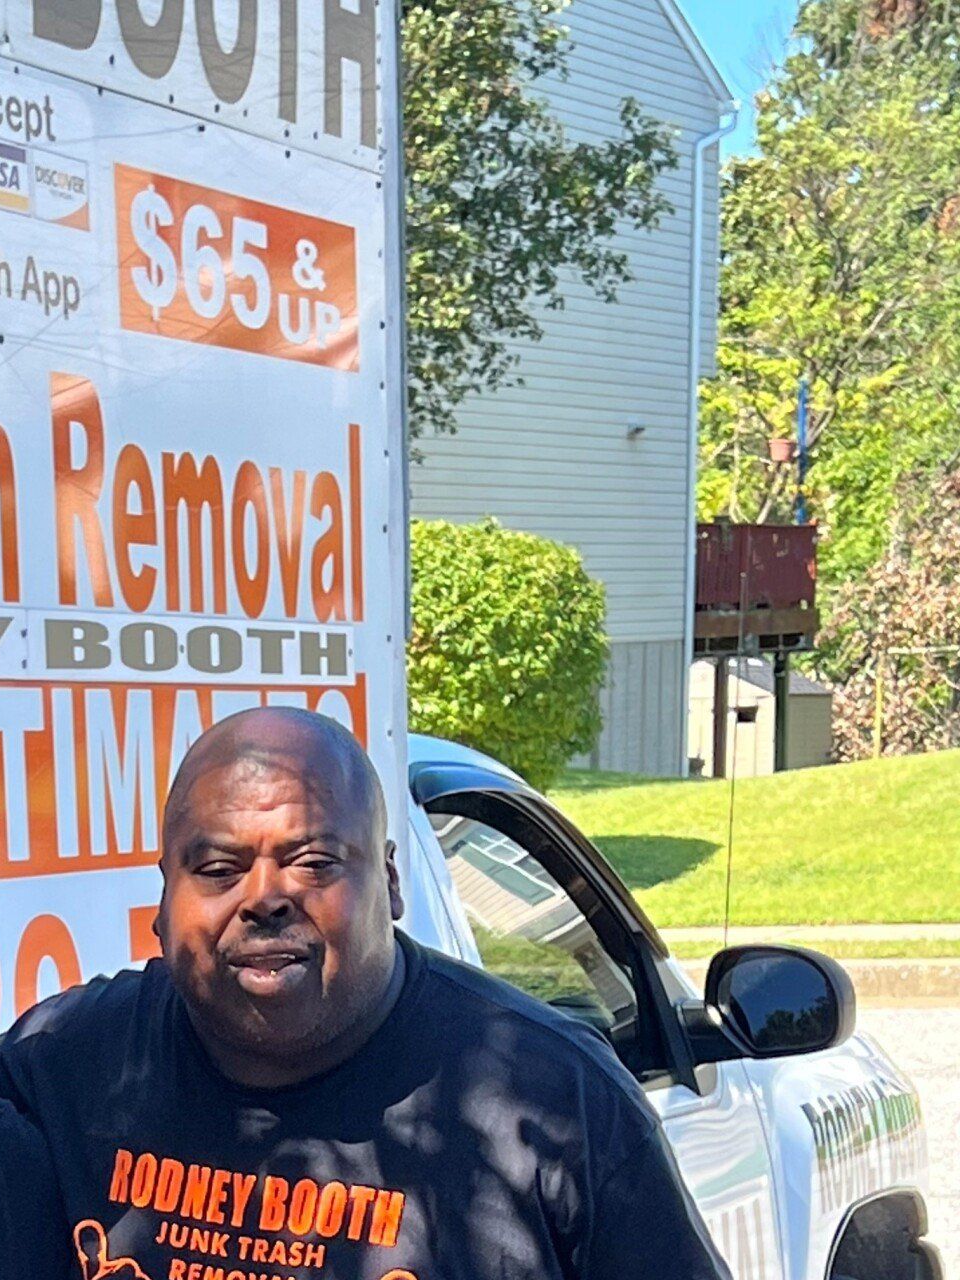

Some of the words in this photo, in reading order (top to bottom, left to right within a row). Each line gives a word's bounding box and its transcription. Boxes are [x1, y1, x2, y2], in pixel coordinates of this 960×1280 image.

[20, 256, 81, 320] App
[131, 184, 271, 330] $65
[291, 238, 327, 291] &
[278, 293, 341, 349] UP
[49, 371, 364, 623] Removal
[43, 618, 348, 677] BOOTH
[109, 1149, 257, 1228] RODNEY
[259, 1175, 406, 1247] BOOTH
[155, 1221, 231, 1258] JUNK
[238, 1236, 326, 1268] TRASH
